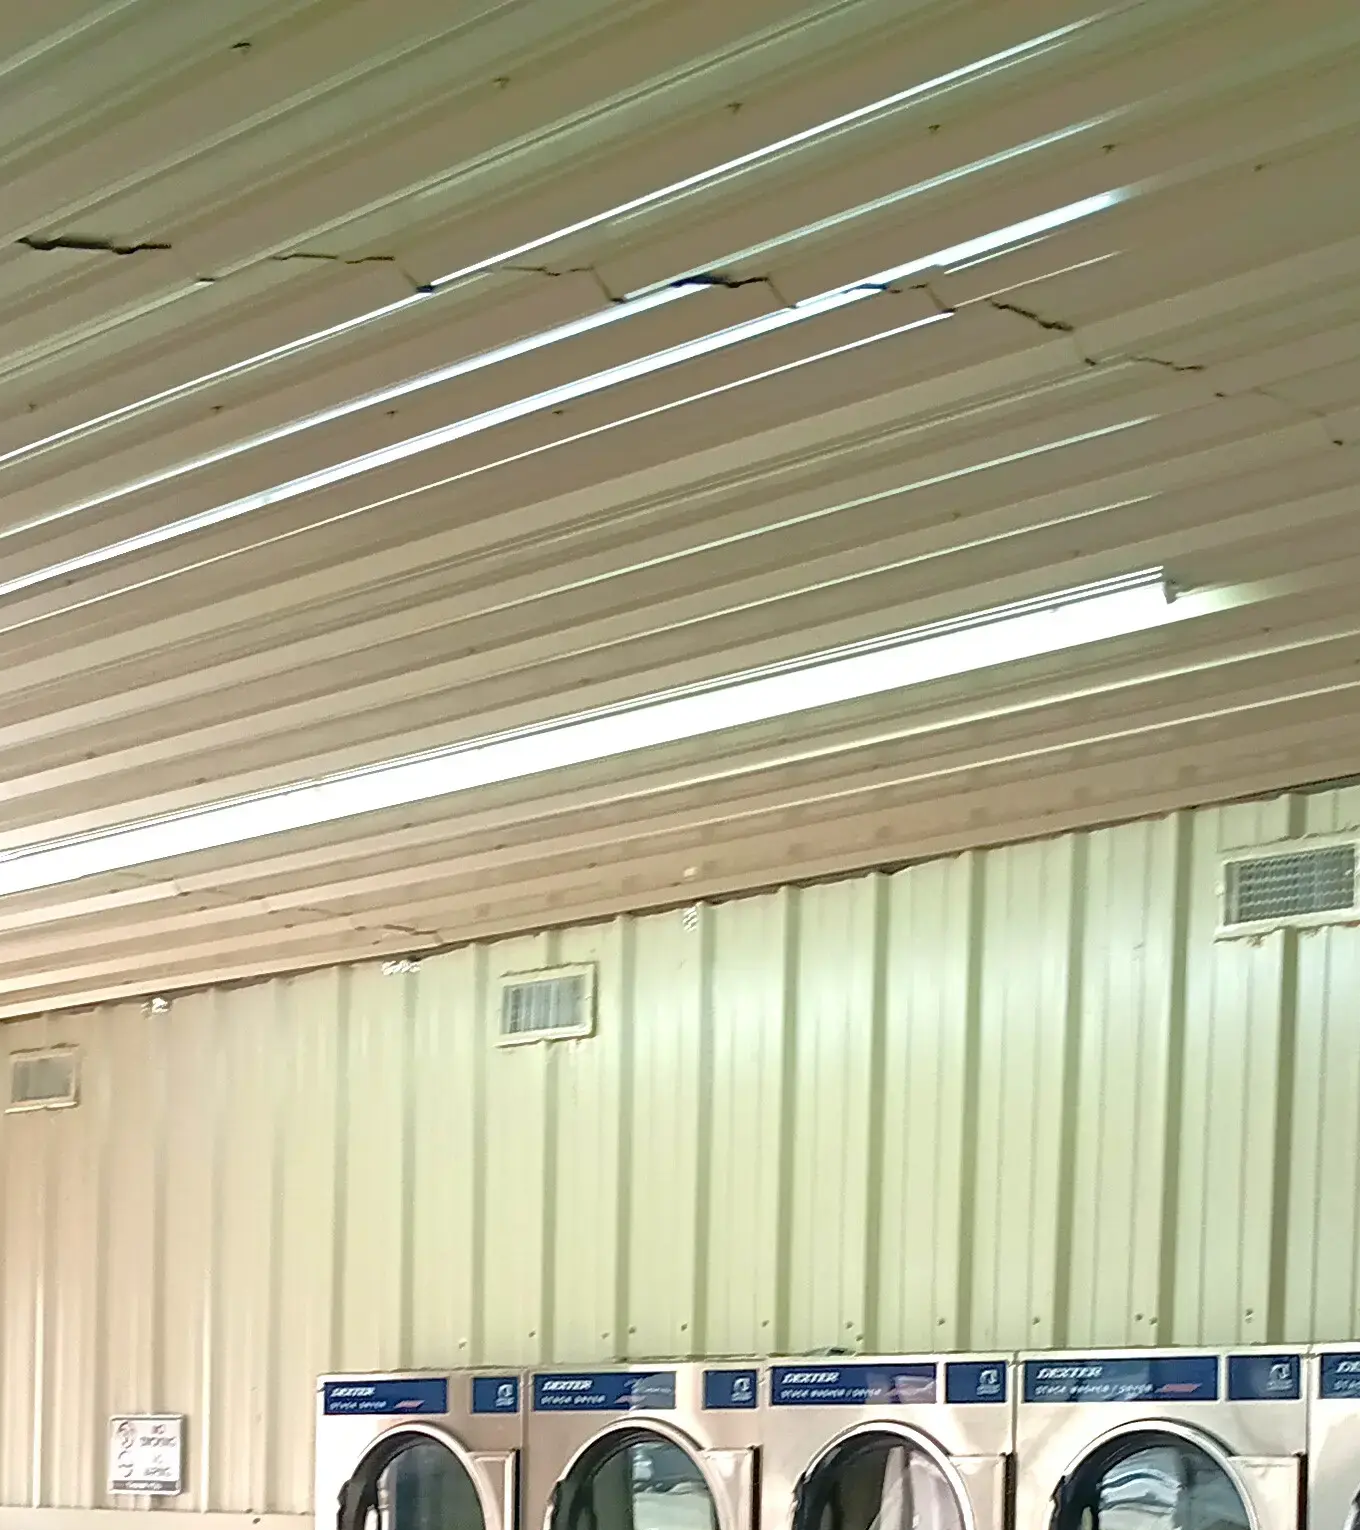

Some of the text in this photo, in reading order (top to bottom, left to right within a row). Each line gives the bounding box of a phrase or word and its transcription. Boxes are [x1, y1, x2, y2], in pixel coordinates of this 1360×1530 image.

[781, 1372, 840, 1384] DEXTER
[1035, 1366, 1103, 1379] DEXTER
[541, 1380, 594, 1391] DEXTER
